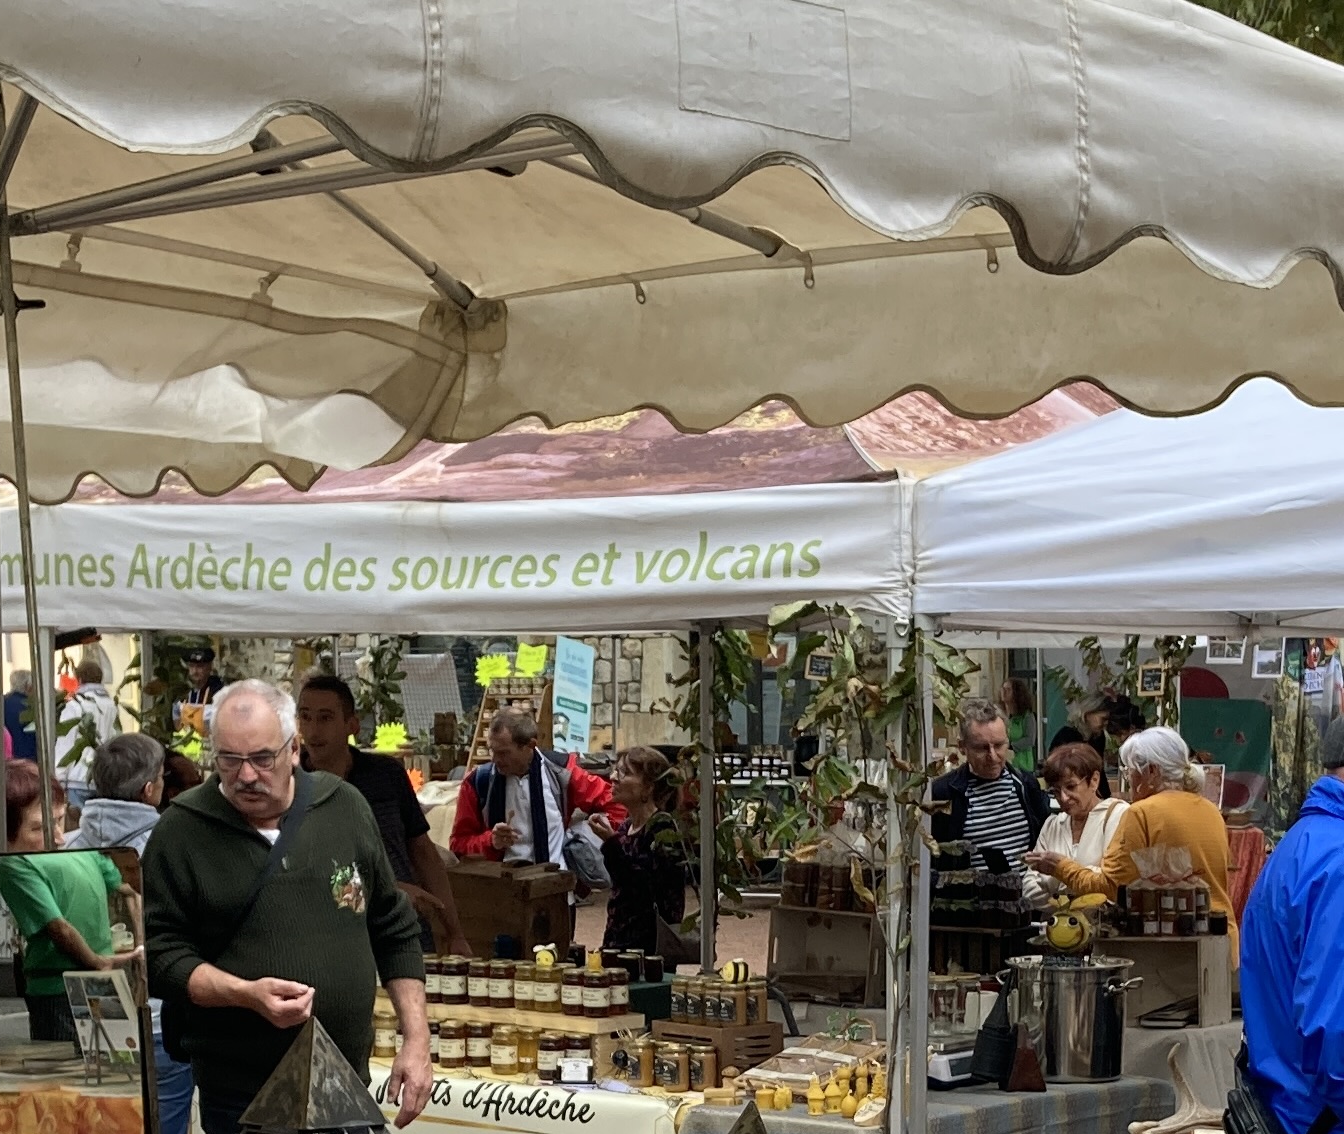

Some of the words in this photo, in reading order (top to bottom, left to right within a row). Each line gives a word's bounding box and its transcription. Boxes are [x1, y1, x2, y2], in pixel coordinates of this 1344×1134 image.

[126, 542, 292, 591] Ardèche
[303, 542, 377, 592] des
[387, 552, 560, 592] sources
[571, 542, 622, 587] et
[634, 531, 823, 585] volcans
[462, 1080, 596, 1124] d'Ardèche
